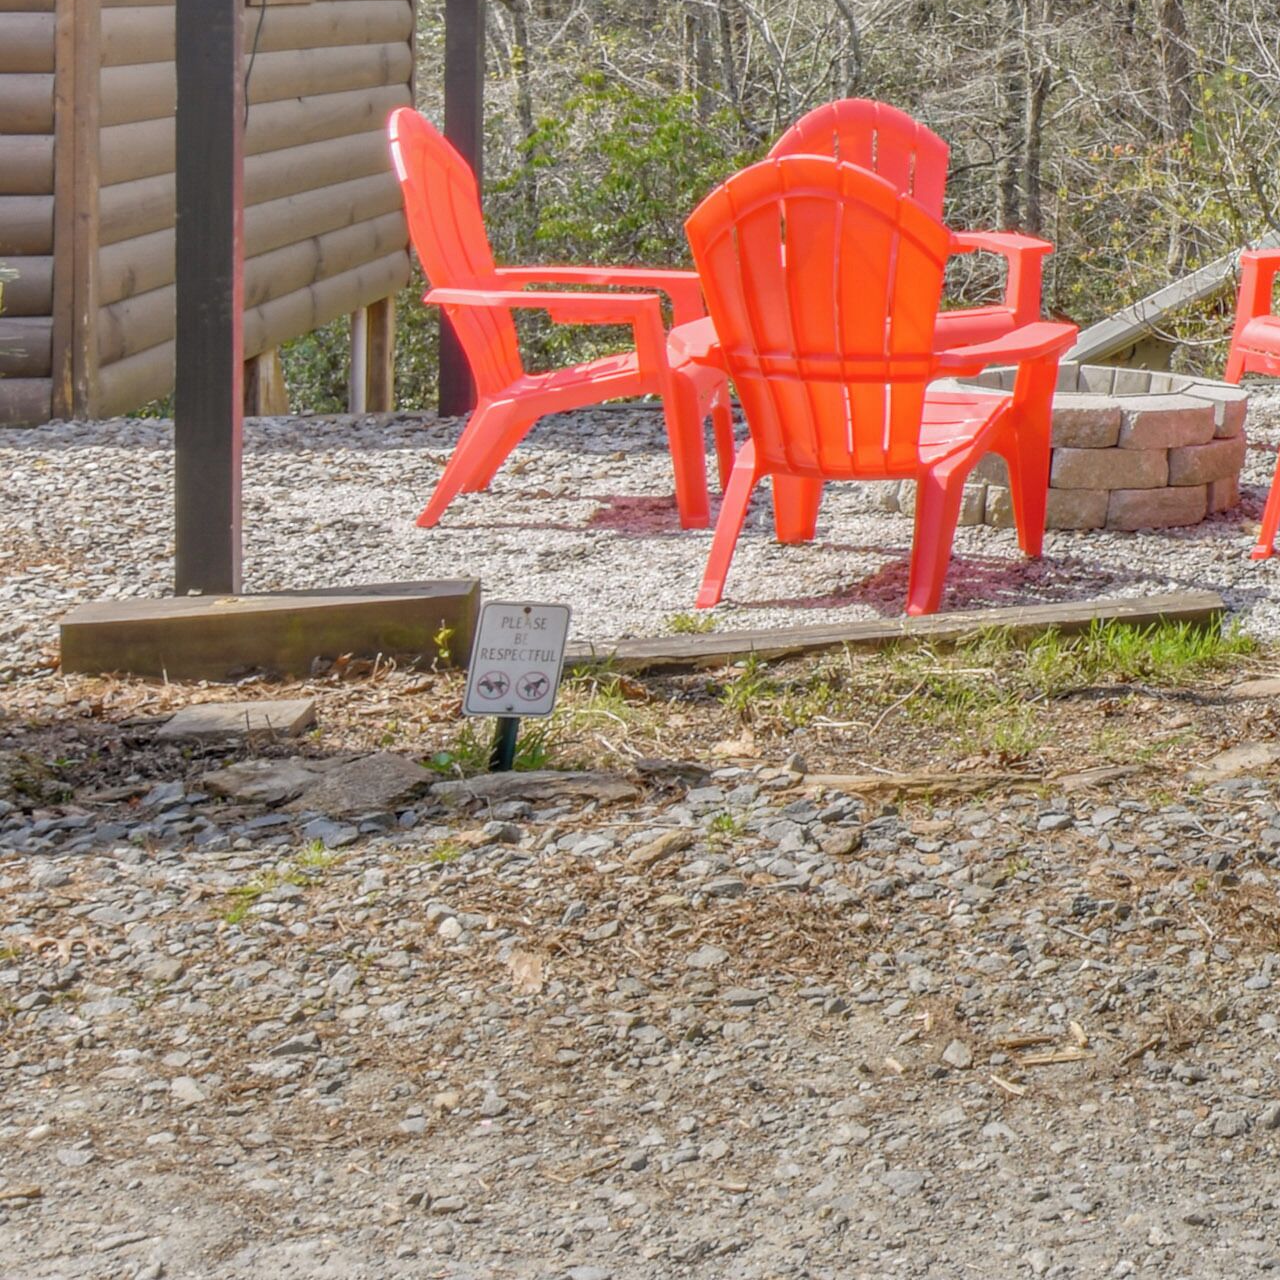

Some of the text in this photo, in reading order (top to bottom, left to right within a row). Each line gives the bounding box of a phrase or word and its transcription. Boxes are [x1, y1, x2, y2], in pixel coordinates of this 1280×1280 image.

[501, 616, 548, 630] PLEASE
[513, 632, 529, 645] BE
[480, 647, 556, 662] RESPECTFUL
